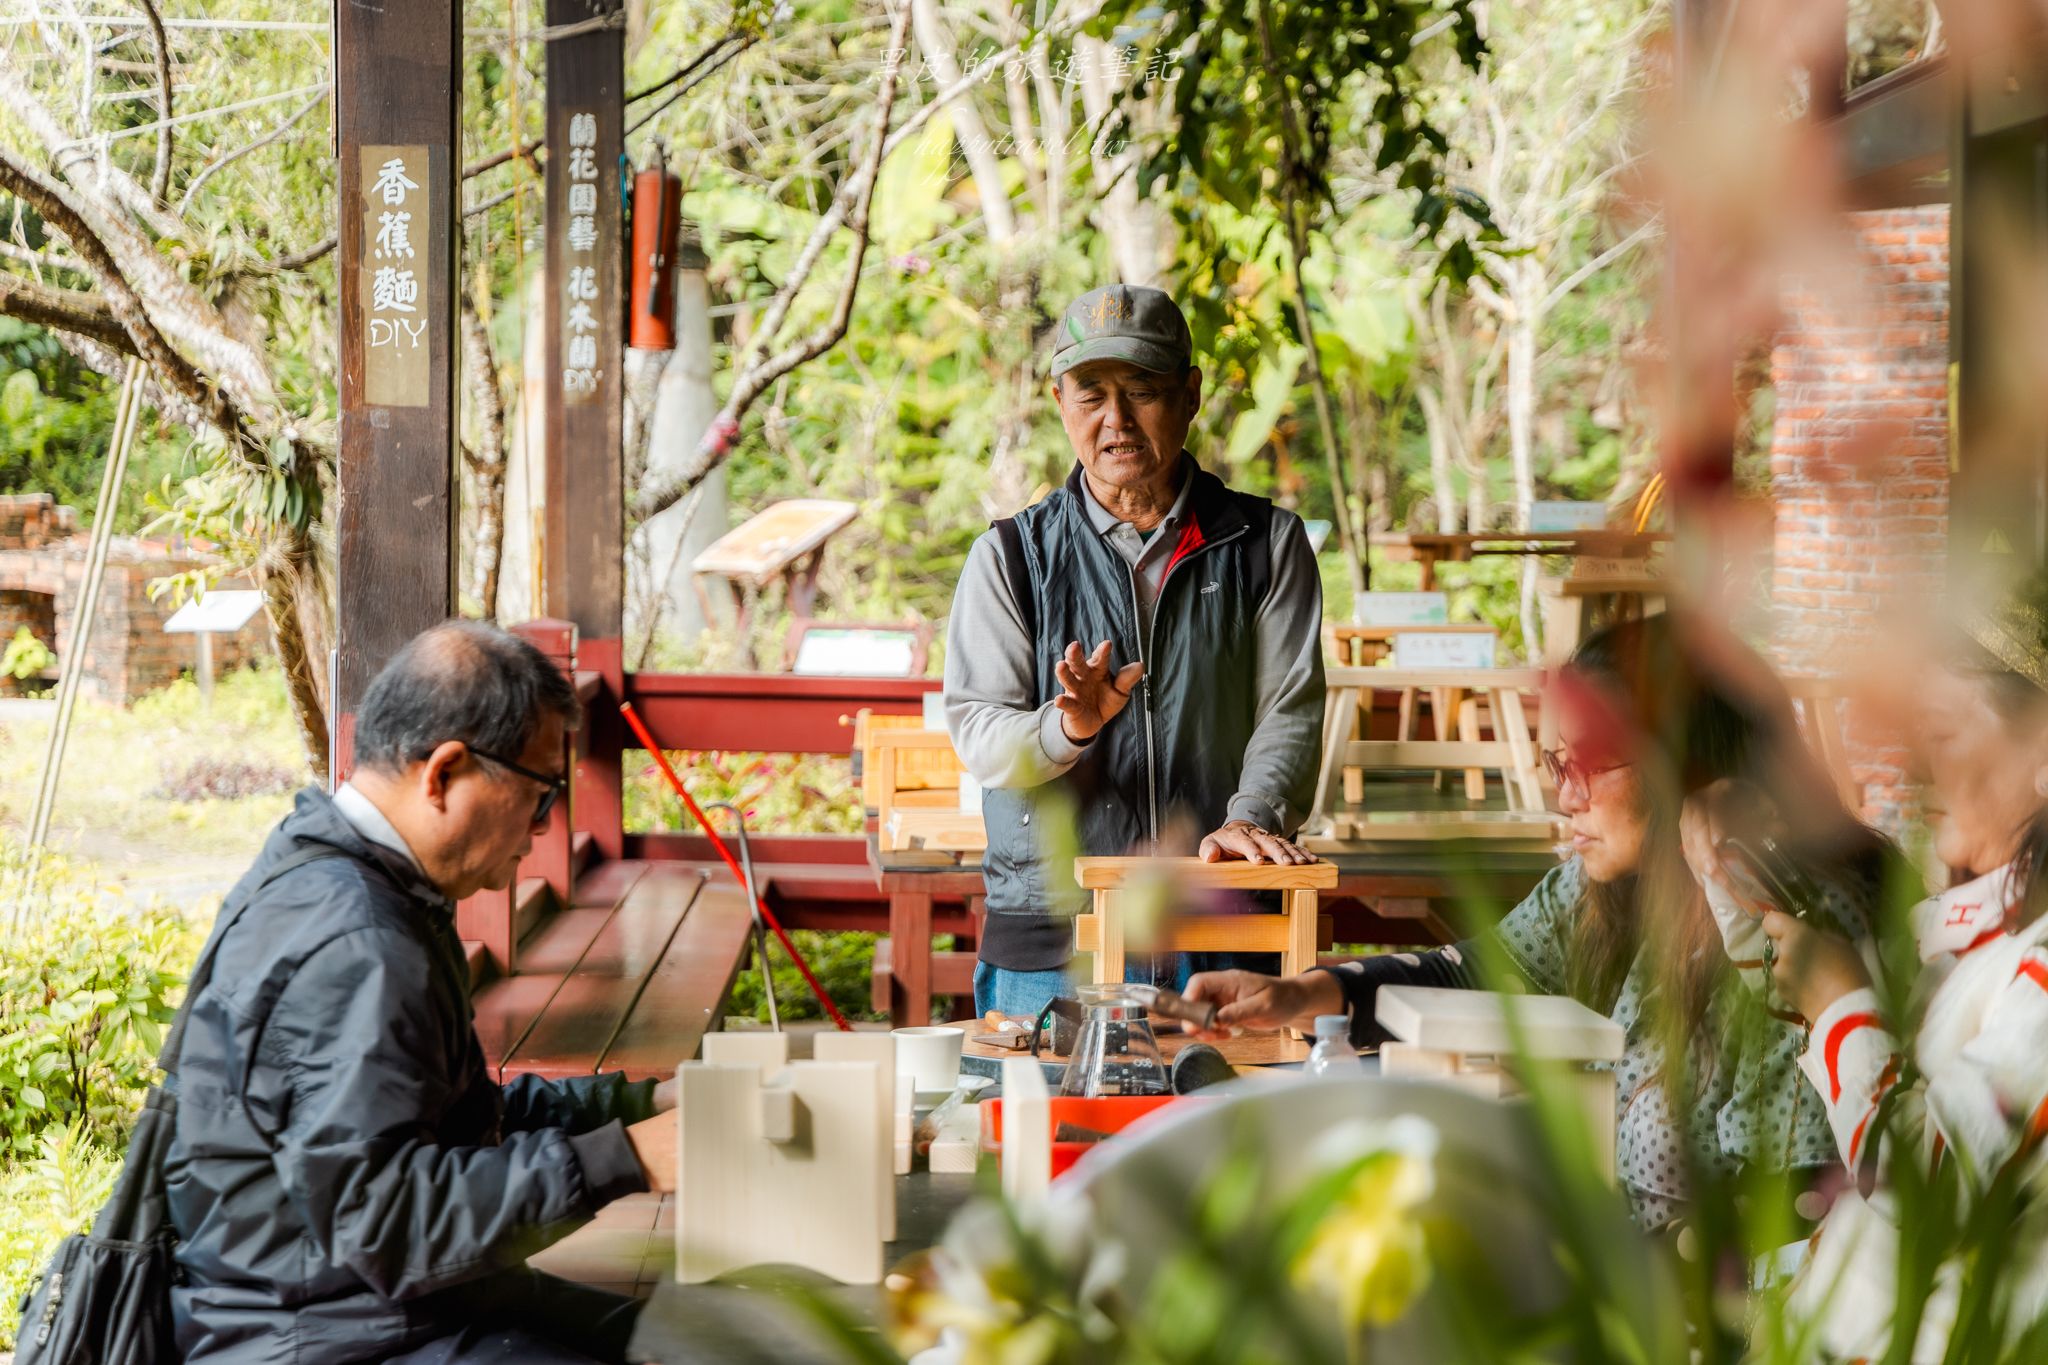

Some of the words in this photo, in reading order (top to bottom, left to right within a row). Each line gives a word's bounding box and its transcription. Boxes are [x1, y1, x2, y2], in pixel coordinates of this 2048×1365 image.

[371, 158, 419, 312] 香蕉麵
[370, 318, 428, 348] DIY
